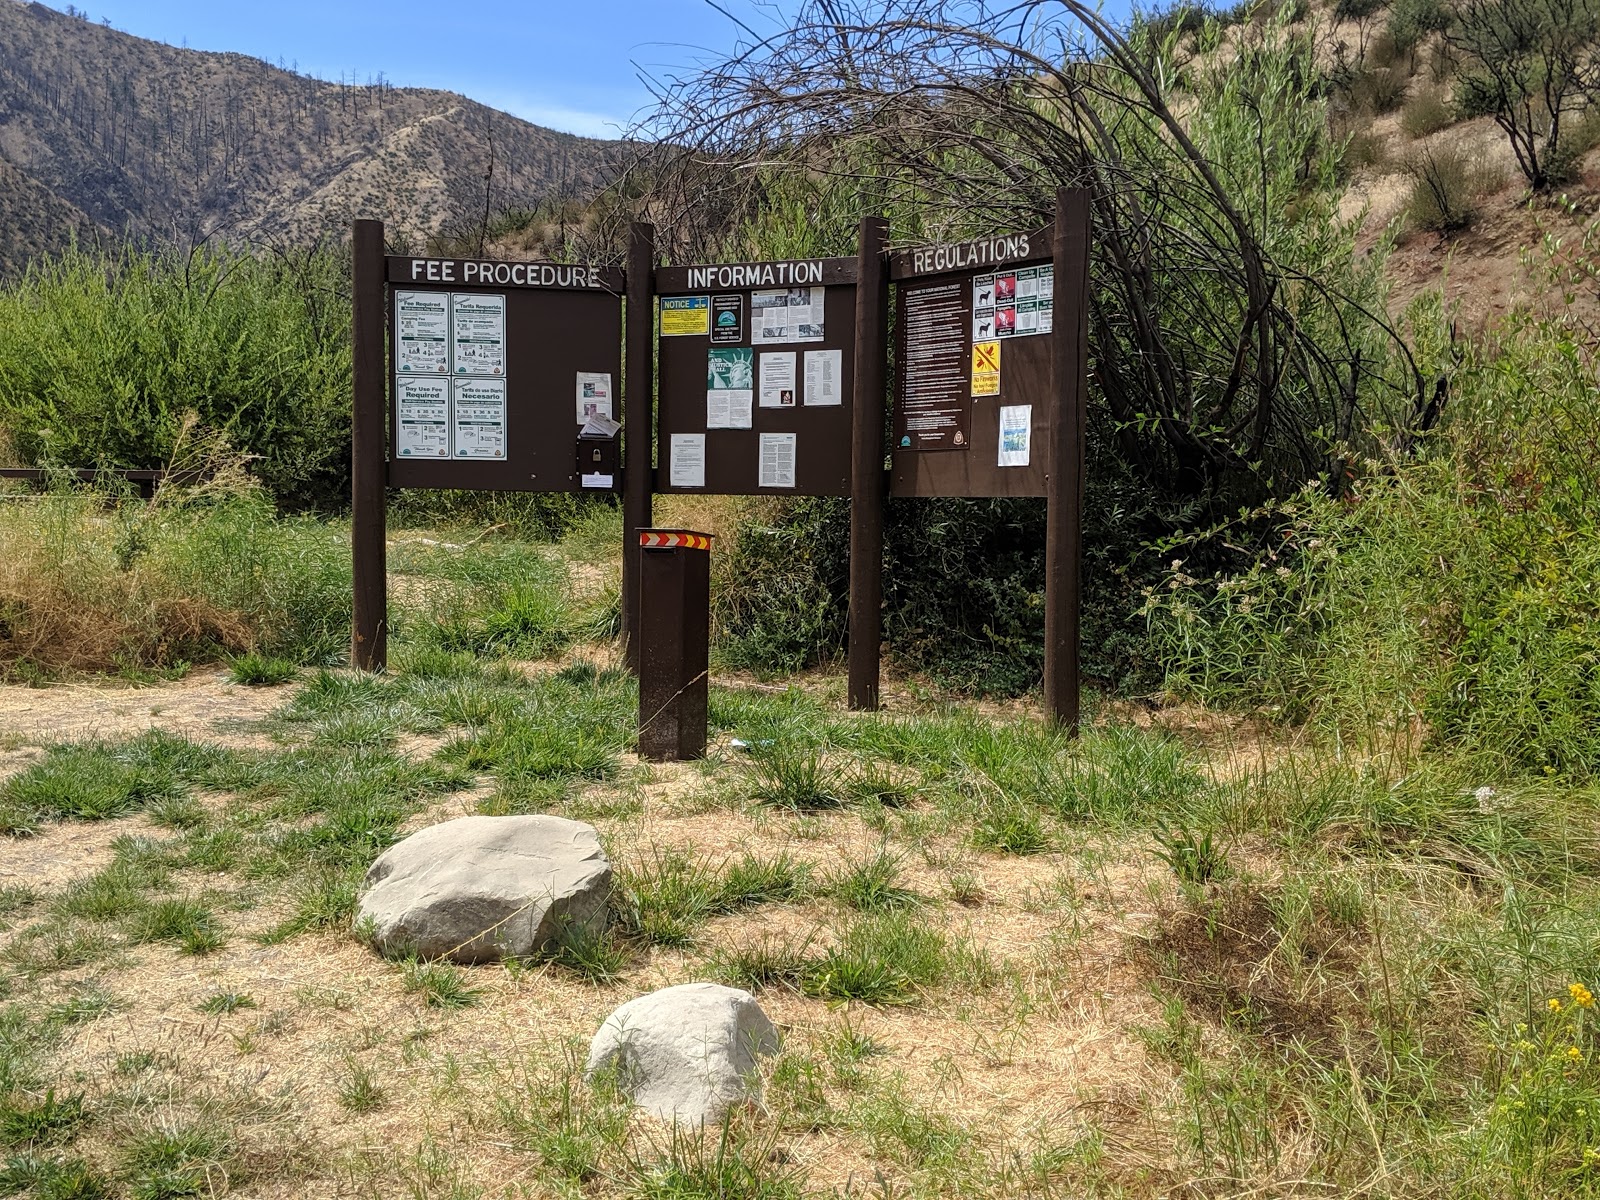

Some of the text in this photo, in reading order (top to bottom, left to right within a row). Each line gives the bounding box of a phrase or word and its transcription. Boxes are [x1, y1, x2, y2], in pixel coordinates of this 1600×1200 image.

[914, 234, 1030, 273] REGULATIONS
[412, 260, 600, 288] FEE PROCEDURE
[688, 261, 823, 289] INFORMATION
[664, 300, 690, 309] NOTICE
